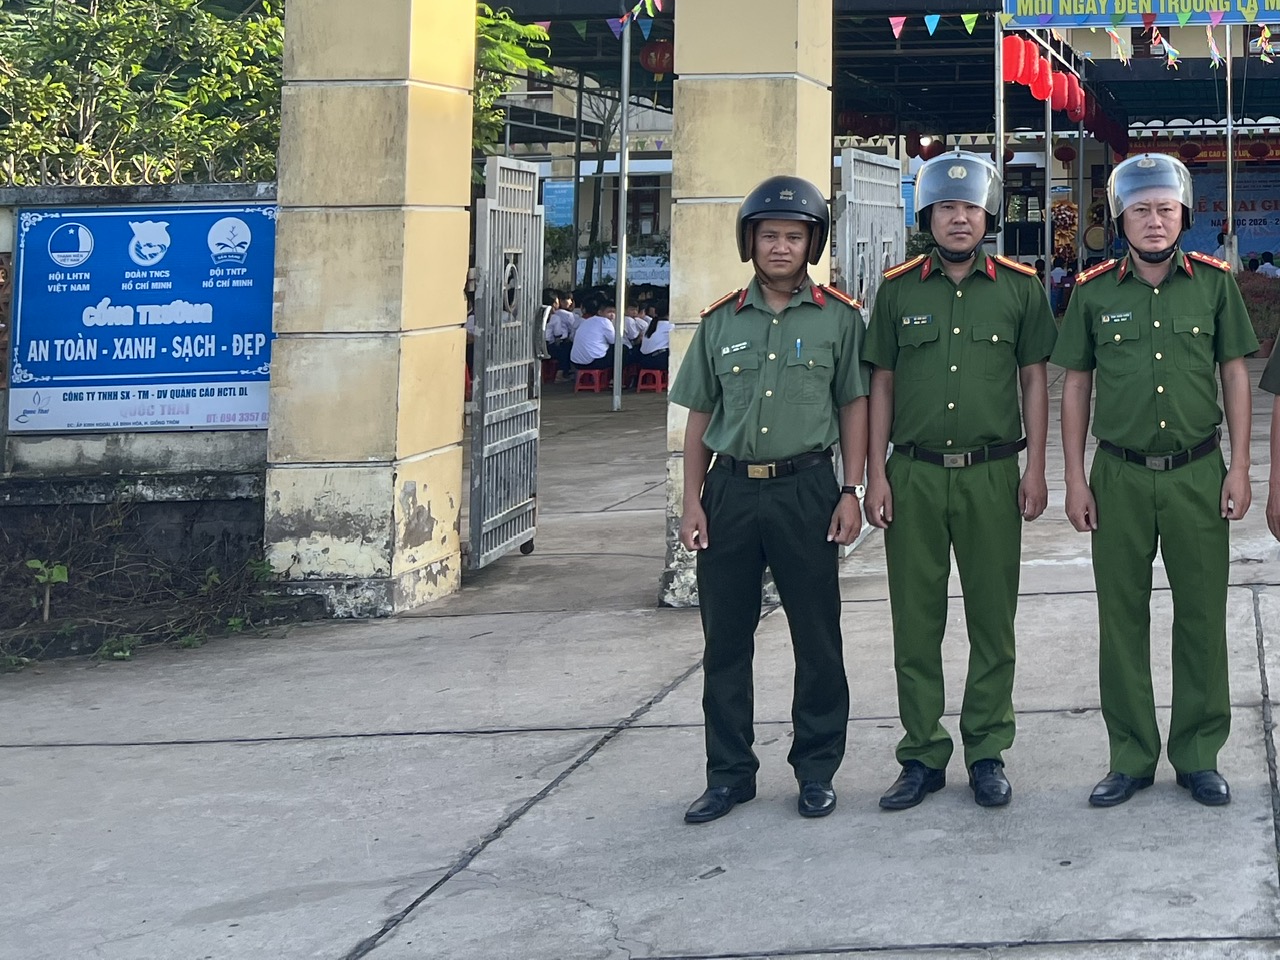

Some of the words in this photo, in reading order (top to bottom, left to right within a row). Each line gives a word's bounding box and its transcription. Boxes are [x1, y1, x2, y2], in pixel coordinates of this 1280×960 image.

[1249, 218, 1267, 226] 2026
[48, 271, 64, 281] HỘI
[67, 272, 90, 280] LHTN
[125, 269, 147, 279] ĐOÀN
[149, 270, 170, 278] TNCS
[209, 267, 224, 277] ĐỘI
[226, 268, 247, 276] TNTP
[135, 281, 149, 290] CHÍ
[216, 278, 229, 287] CHÍ
[232, 279, 253, 287] MINH
[48, 283, 67, 293] VIỆT
[27, 340, 49, 362] AN
[54, 333, 97, 361] TOÀN
[112, 338, 156, 360] XANH
[172, 334, 216, 362] SẠCH
[232, 333, 266, 360] ĐẸP
[62, 391, 84, 402] CÔNG
[86, 391, 95, 401] TY
[98, 391, 118, 401] TNHH
[120, 390, 130, 400] SX
[138, 390, 149, 399] TM
[157, 389, 167, 399] DV
[170, 387, 196, 399] QUẢNG
[199, 387, 214, 397] CÁO
[217, 387, 236, 396] HCTL
